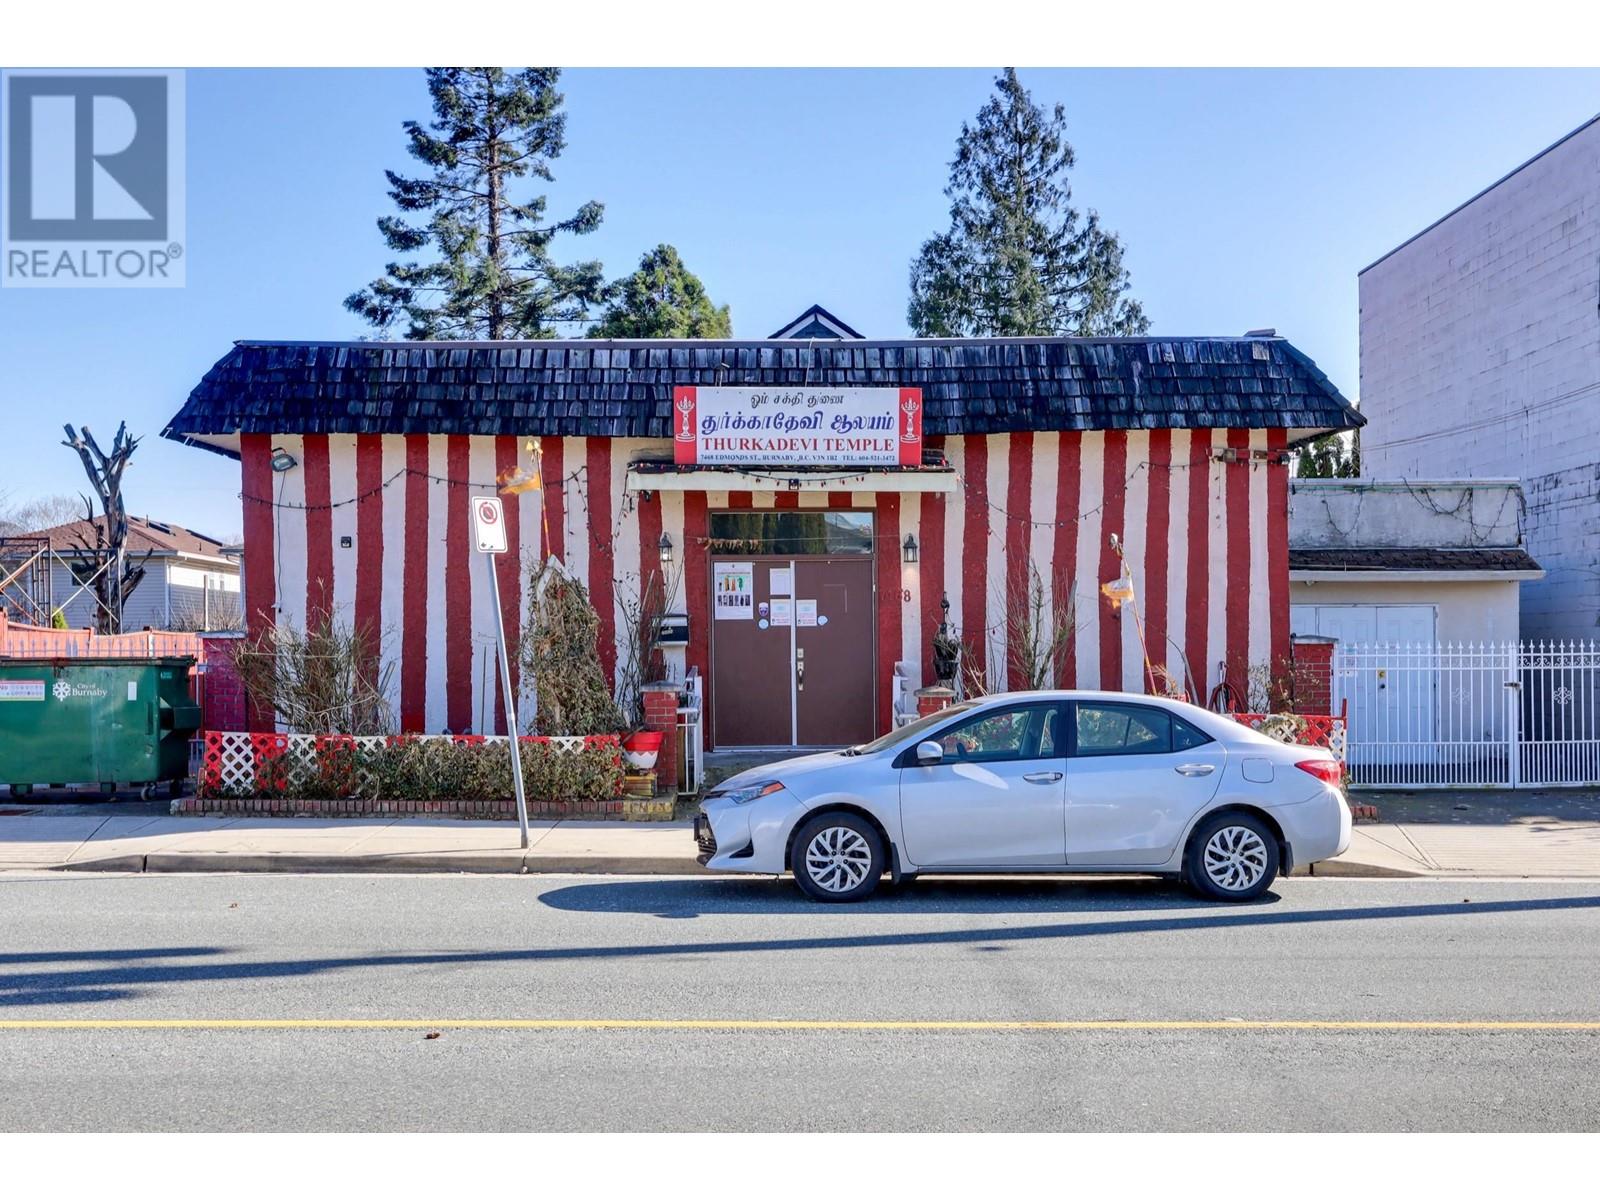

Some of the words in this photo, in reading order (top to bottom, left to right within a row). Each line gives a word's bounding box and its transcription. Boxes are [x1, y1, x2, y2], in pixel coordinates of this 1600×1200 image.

[774, 392, 804, 406] சக்தி
[701, 410, 824, 435] துர்க்காதேவி
[831, 411, 895, 434] ஆலயம்
[702, 437, 818, 451] THURKADEVI
[823, 438, 895, 452] TEMPLE
[72, 688, 108, 698] Burnaby
